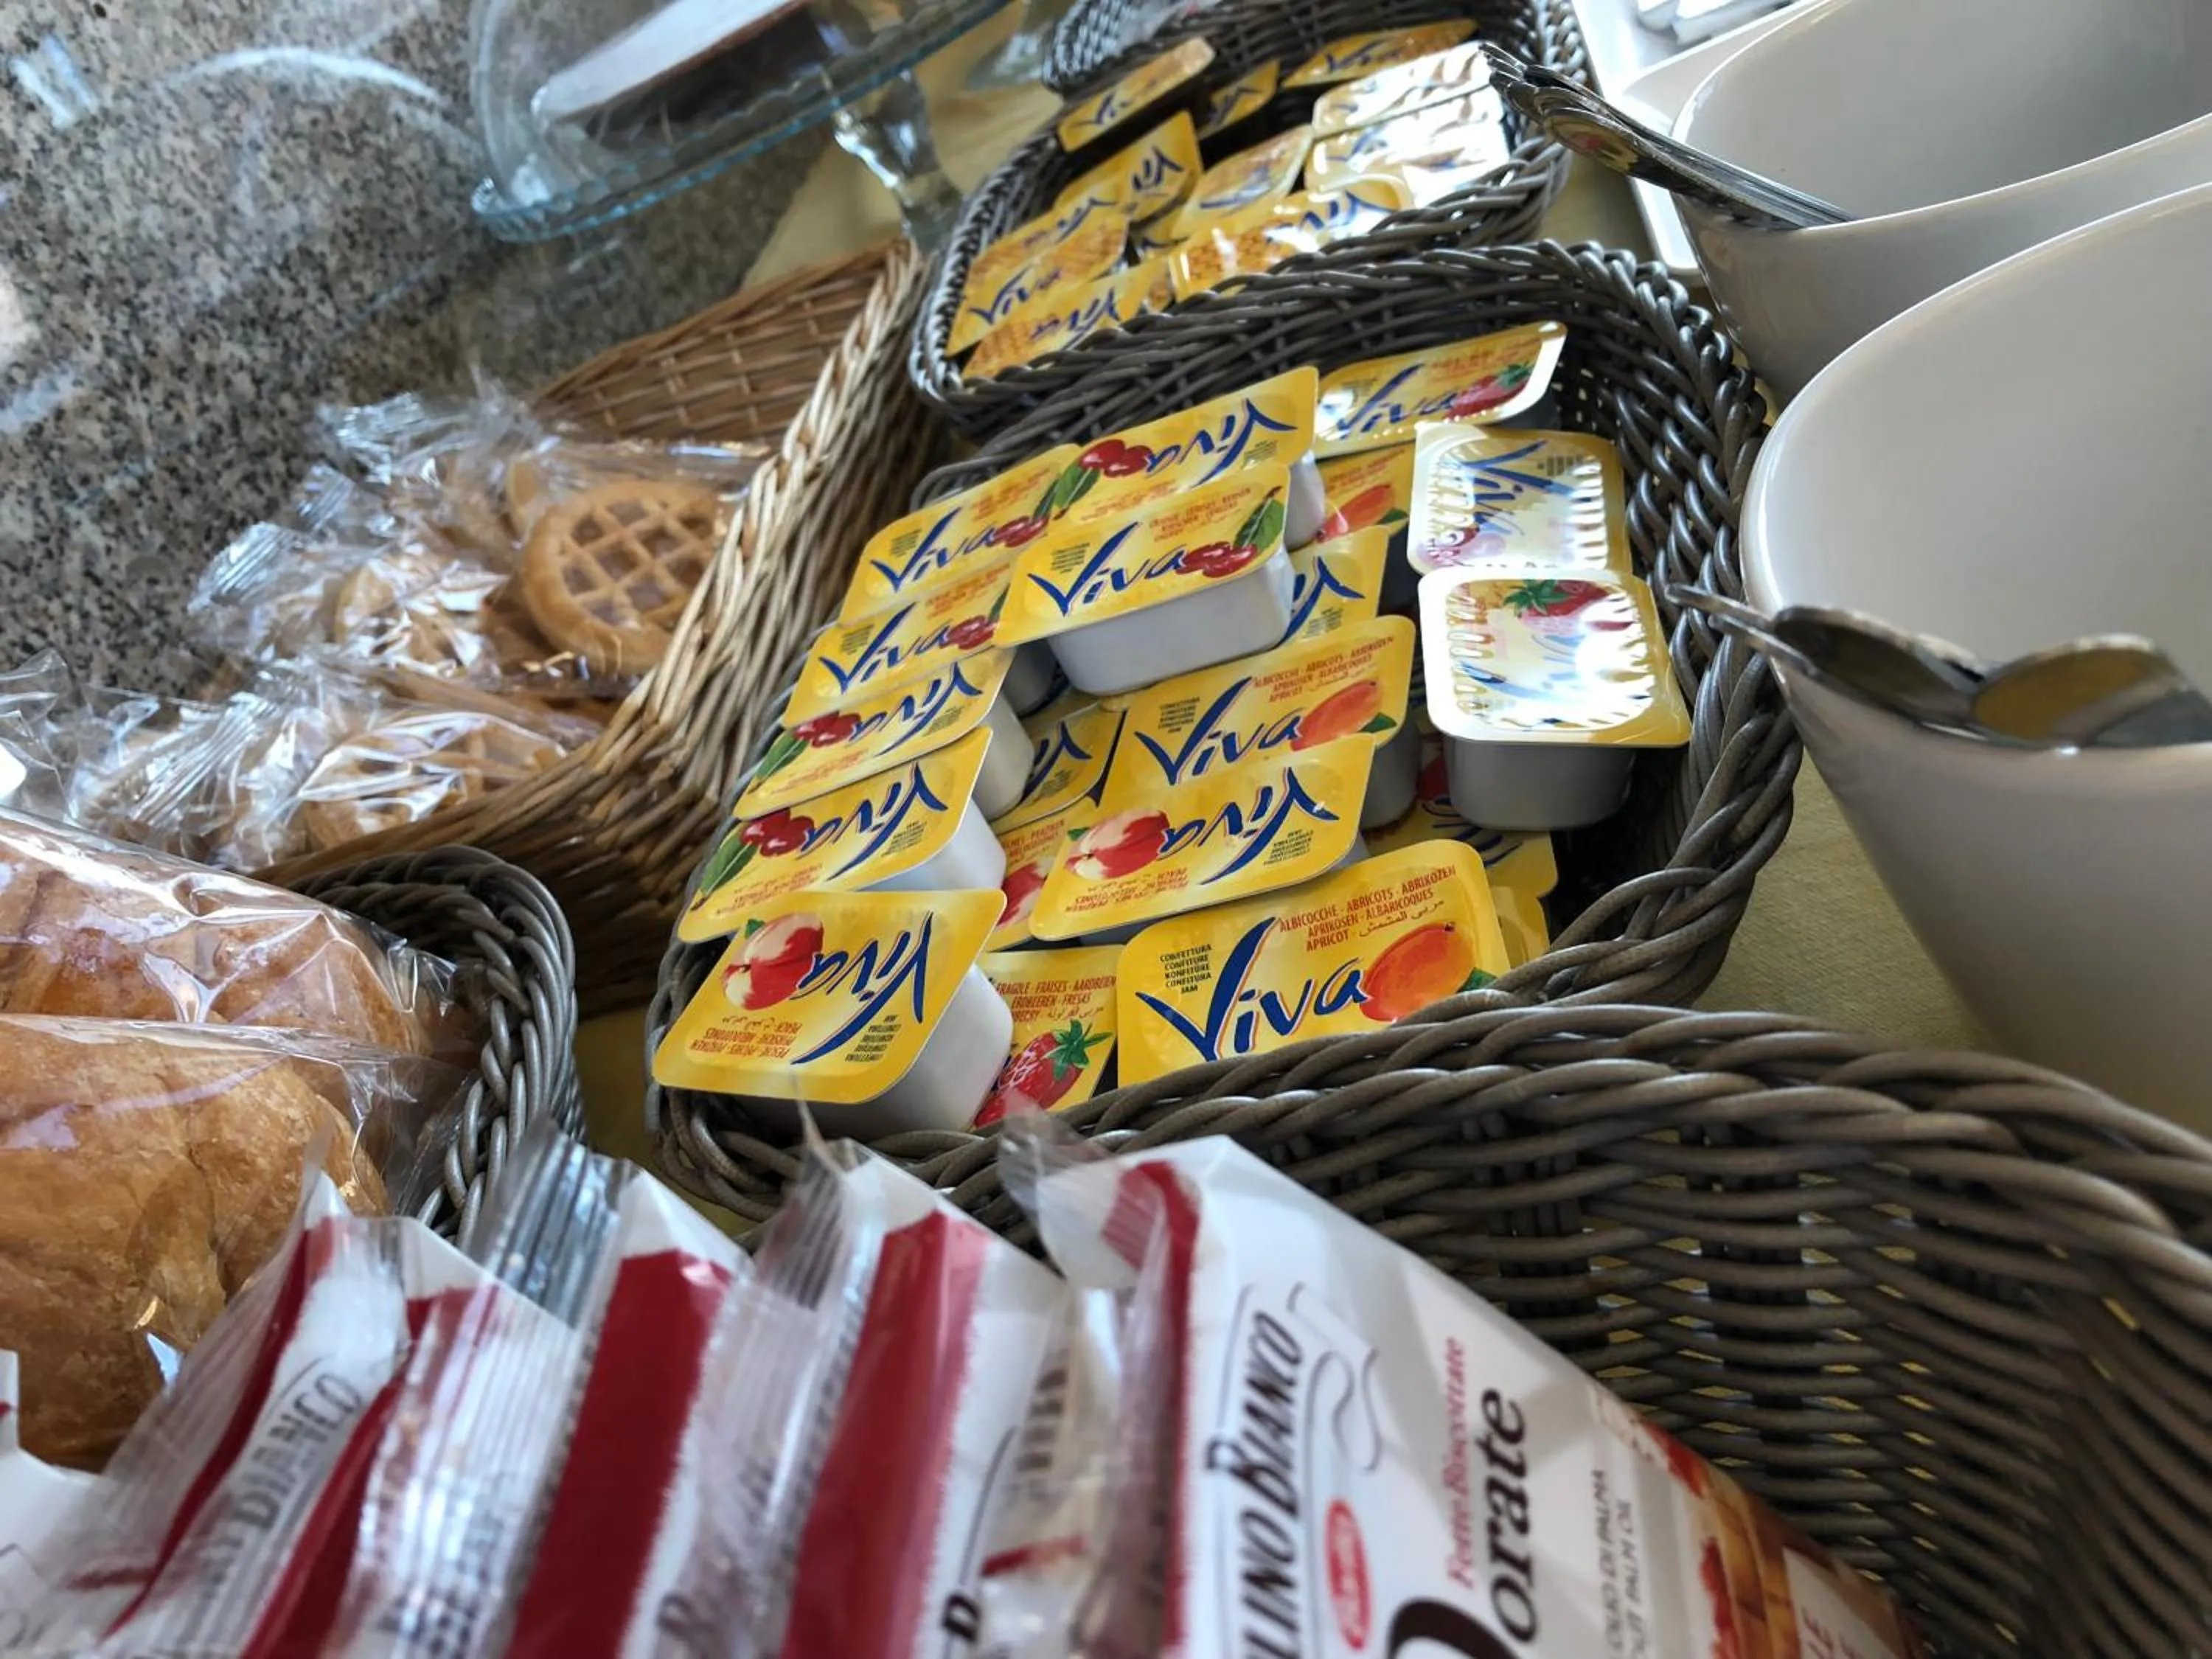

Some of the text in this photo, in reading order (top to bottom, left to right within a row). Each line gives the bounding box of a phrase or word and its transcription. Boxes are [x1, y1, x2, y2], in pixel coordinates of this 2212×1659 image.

[1146, 398, 1297, 487] Viva
[1337, 363, 1458, 440] Viva
[870, 507, 998, 594] Viva
[1027, 521, 1187, 618] Viva
[818, 602, 952, 695] Viva
[849, 661, 984, 759] Viva
[1133, 676, 1304, 786] Viva
[800, 762, 948, 883] Viva
[1160, 766, 1339, 886] Viva
[1280, 864, 1456, 933] ALBICOCCHE ABRICOTS ABRIKOZEN
[1306, 928, 1349, 952] APRICOT
[1307, 887, 1434, 939] APRIKOSEN ALBARICOQUES
[790, 911, 935, 1065] Viva
[1135, 917, 1370, 1062] Viva
[1160, 943, 1212, 963] CONFETTURA
[1181, 984, 1198, 995] JAM
[1206, 1310, 1304, 1659] LINO BIANCO
[1590, 1470, 1612, 1546] PALMA
